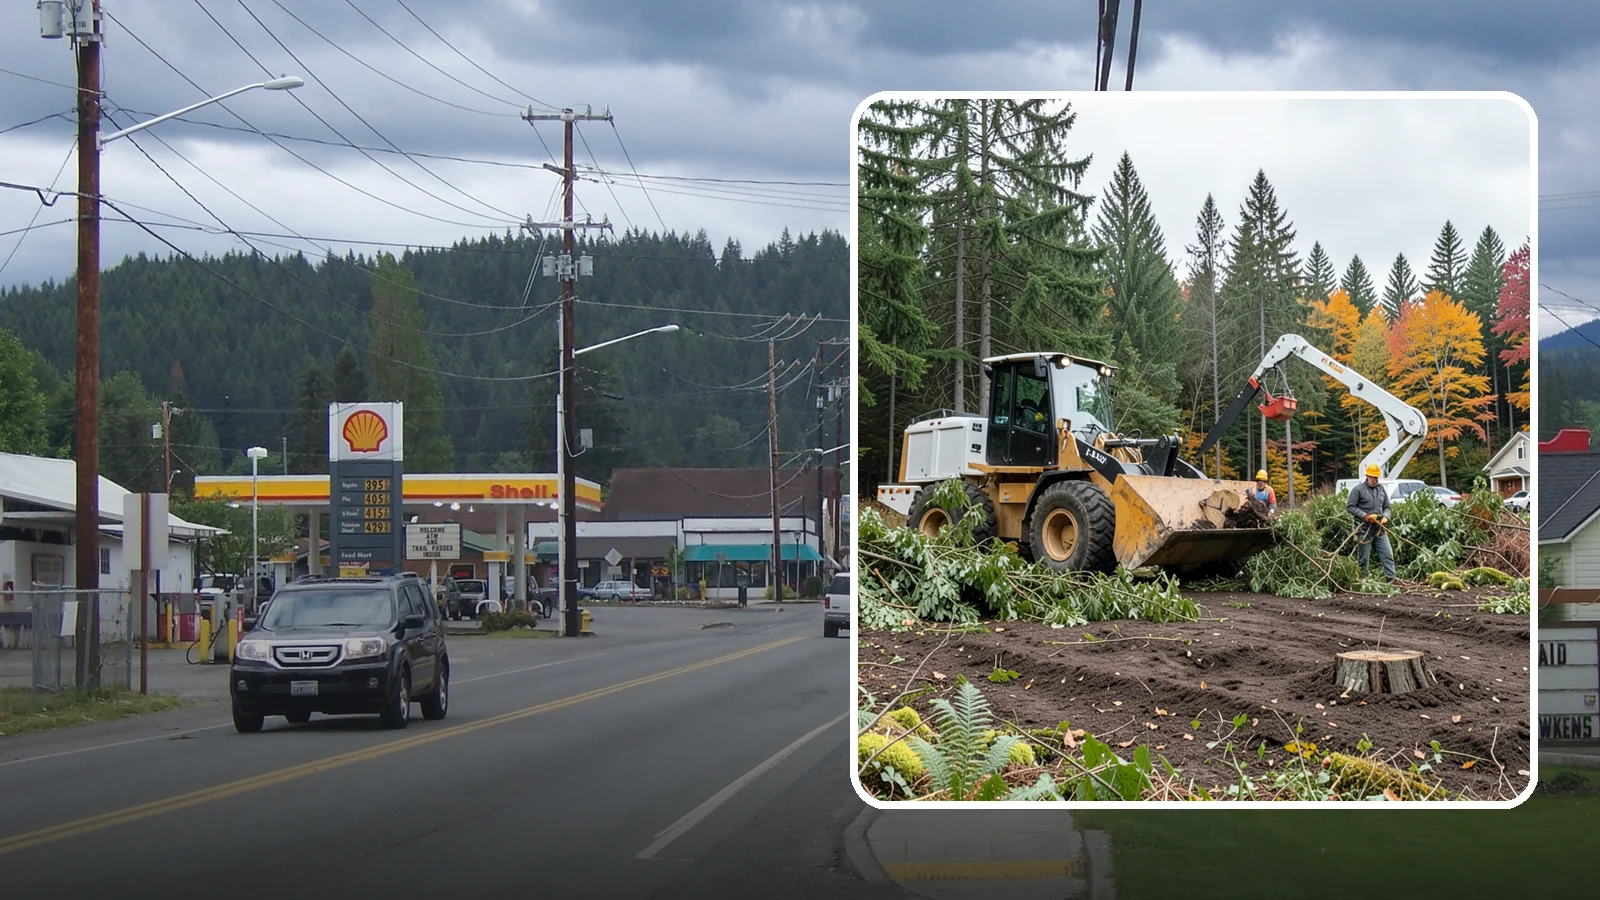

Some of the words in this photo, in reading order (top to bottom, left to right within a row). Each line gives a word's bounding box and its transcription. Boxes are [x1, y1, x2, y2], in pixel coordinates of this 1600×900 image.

[366, 480, 383, 490] 395
[490, 484, 547, 498] Shell
[366, 494, 383, 504] 405
[366, 508, 383, 518] 415
[366, 522, 383, 532] 429
[1538, 643, 1567, 665] AID
[1538, 716, 1592, 738] WKENS
